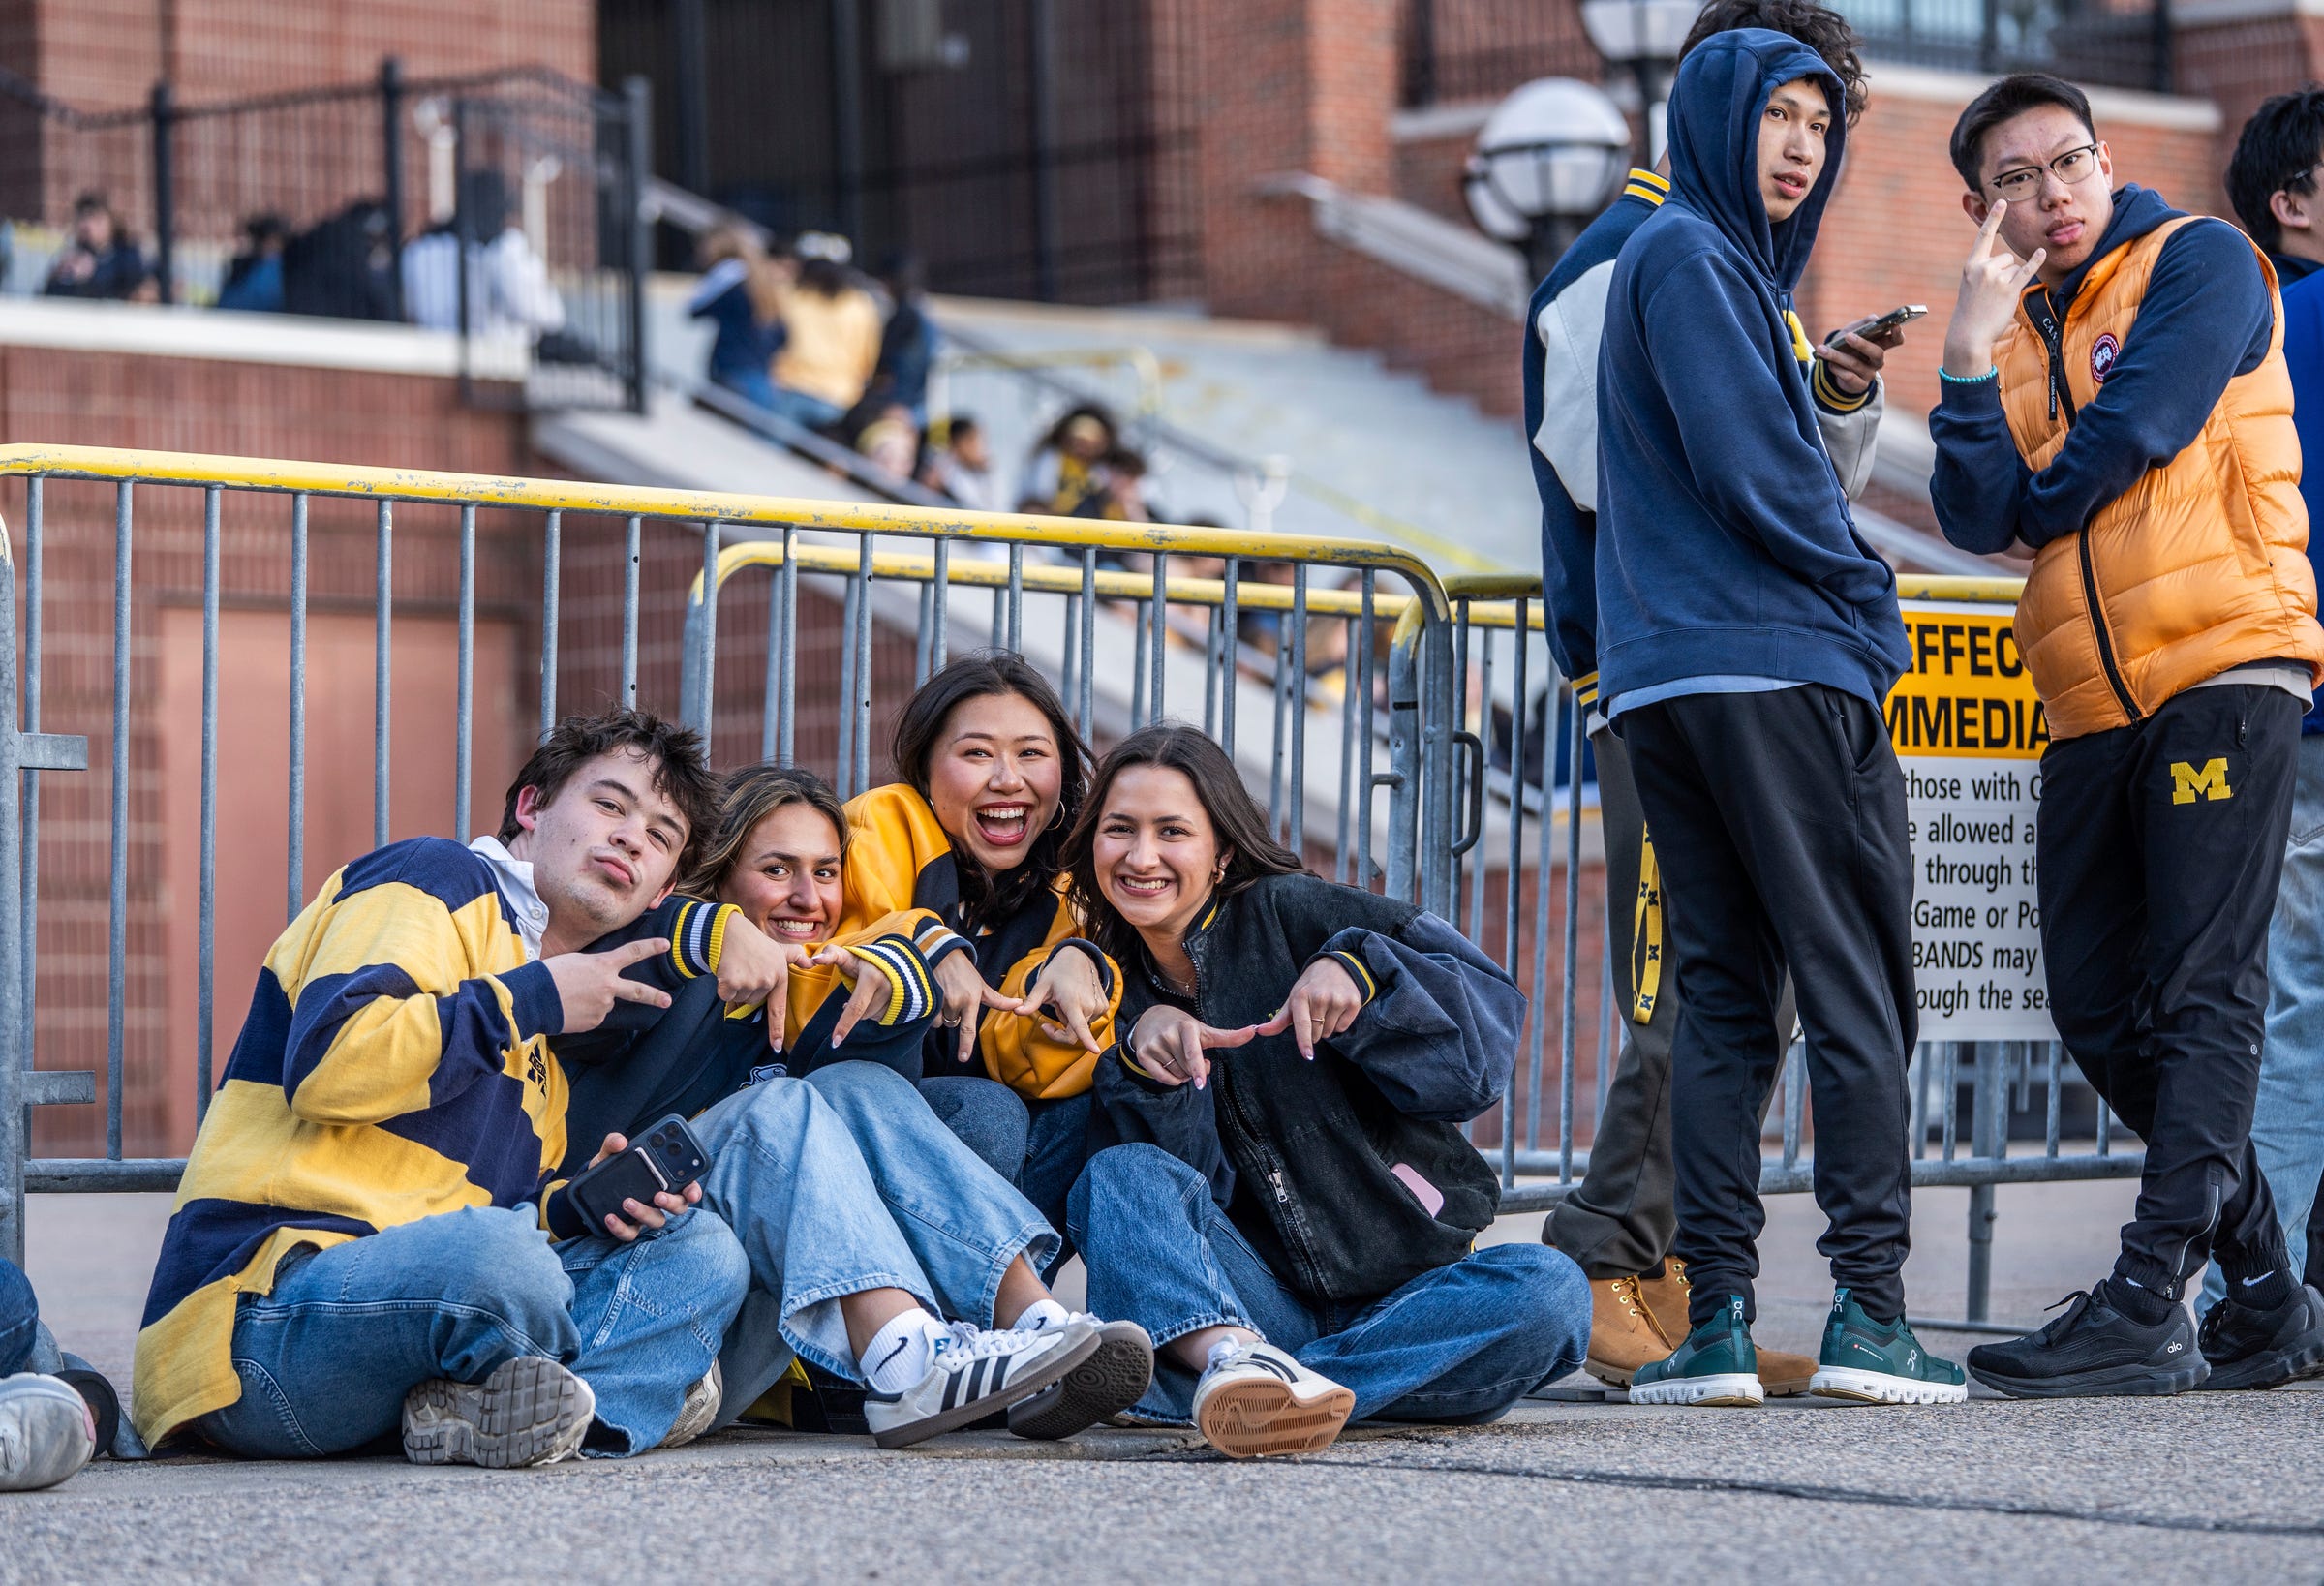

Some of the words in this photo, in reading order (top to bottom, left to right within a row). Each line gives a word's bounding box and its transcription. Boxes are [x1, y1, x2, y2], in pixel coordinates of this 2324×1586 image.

[1972, 771, 2021, 801] with
[2170, 757, 2231, 806] M
[1928, 813, 2014, 844] allowed
[1925, 854, 2012, 894] through
[1986, 906, 2009, 929] or
[1993, 947, 2038, 977] may
[1978, 980, 2013, 1010] the
[2167, 1340, 2183, 1354] alo
